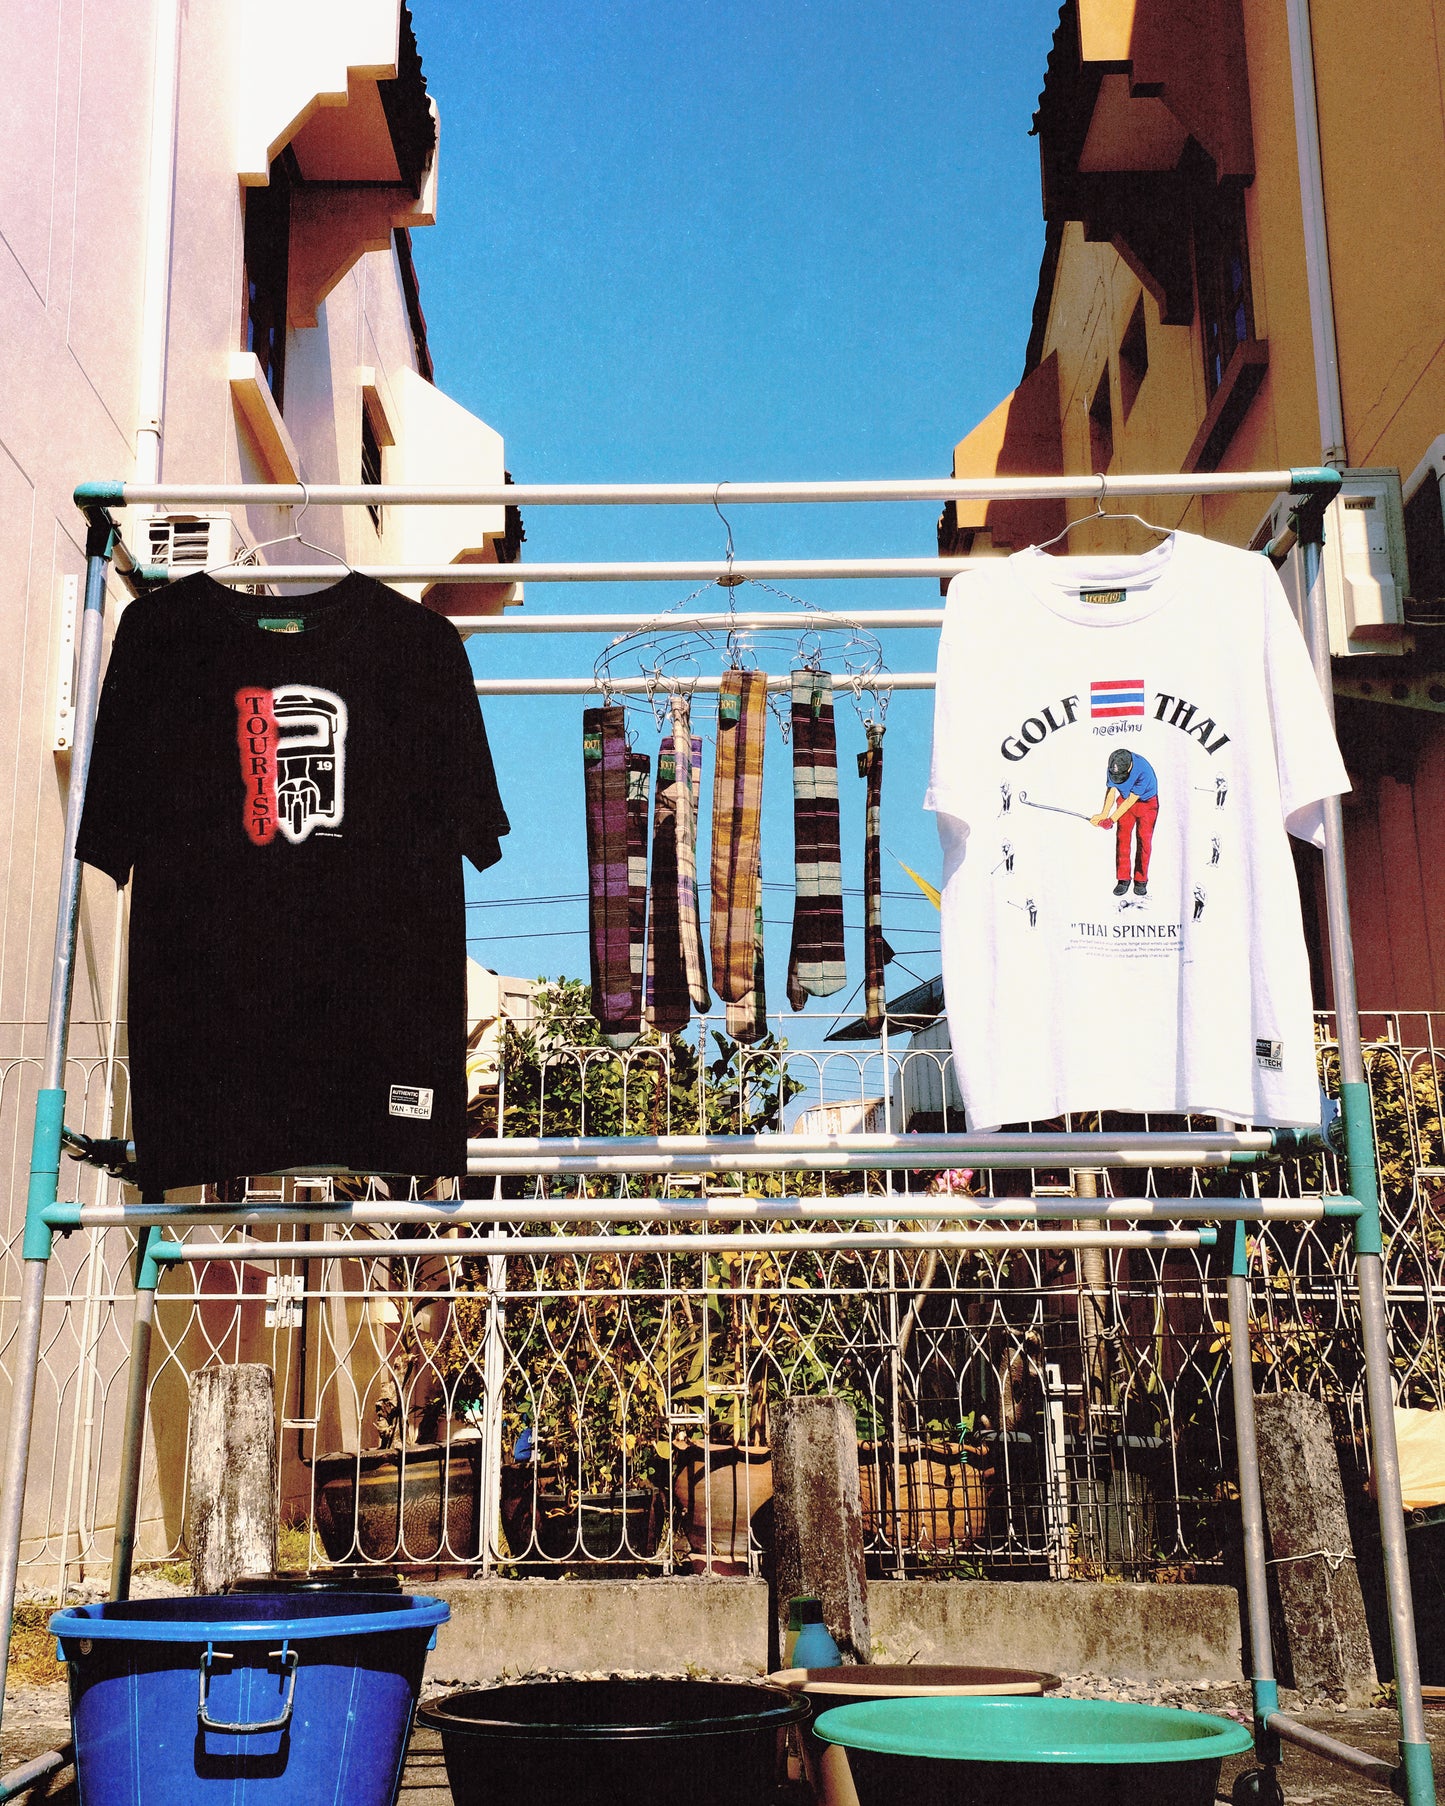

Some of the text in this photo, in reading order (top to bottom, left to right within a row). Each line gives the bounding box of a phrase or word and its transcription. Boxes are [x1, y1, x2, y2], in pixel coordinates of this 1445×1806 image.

[1000, 692, 1231, 762] GOLF THAI
[245, 696, 272, 836] TOURIST
[316, 760, 333, 771] 19
[1112, 924, 1182, 938] SPINNER"
[1265, 1058, 1281, 1067] TECH
[410, 1106, 429, 1114] TECH
